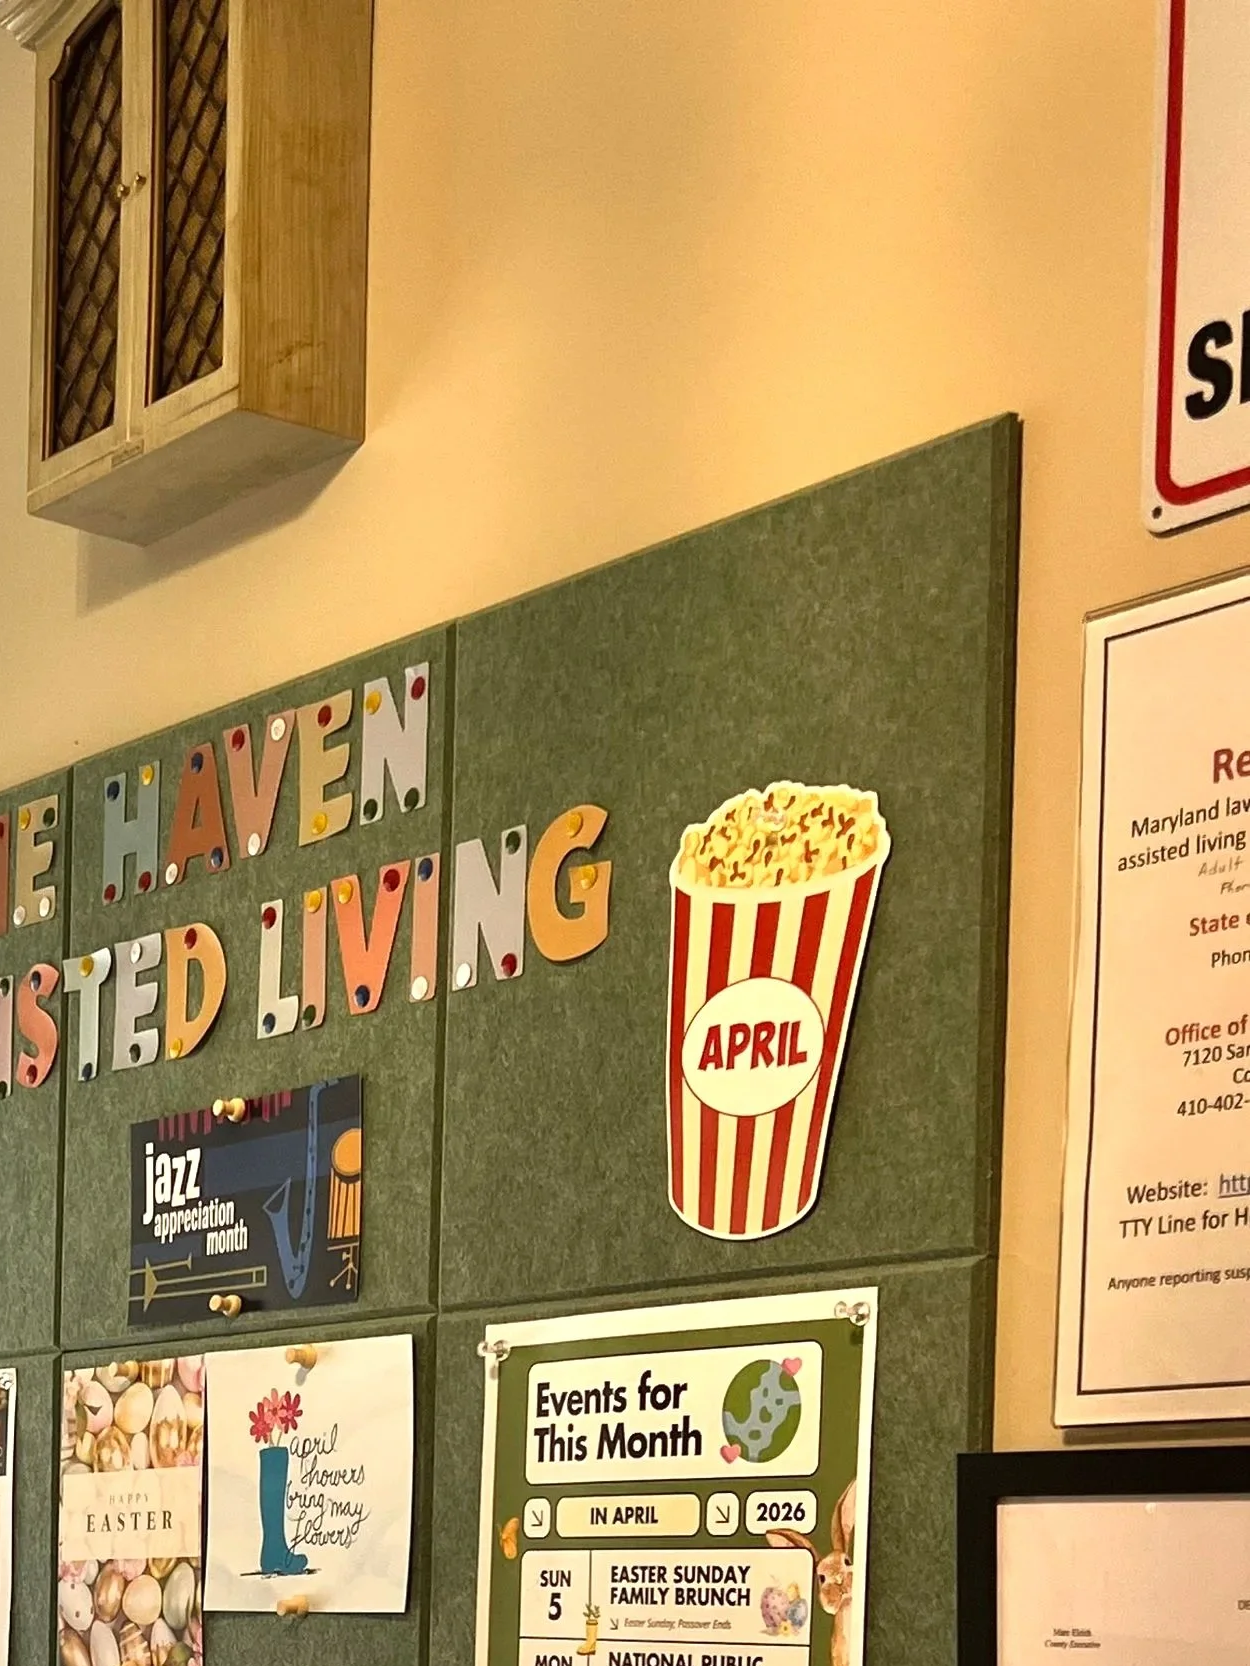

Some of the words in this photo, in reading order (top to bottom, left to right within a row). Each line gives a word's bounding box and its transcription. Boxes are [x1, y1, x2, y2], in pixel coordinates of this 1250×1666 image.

[1185, 309, 1250, 421] S
[102, 661, 430, 905] HAVEN
[1130, 799, 1220, 839] Maryland
[1117, 837, 1190, 872] assisted
[1196, 829, 1247, 855] living
[1198, 856, 1246, 877] Adult
[257, 804, 612, 1040] LIVING
[1189, 911, 1239, 937] State
[697, 1020, 808, 1072] APRIL
[1165, 1021, 1221, 1046] Office
[1227, 1014, 1249, 1036] of
[1182, 1045, 1223, 1067] 7120
[143, 1142, 201, 1225] jazz
[1126, 1179, 1208, 1205] Website:
[153, 1197, 235, 1245] appreciation
[206, 1217, 248, 1256] month
[1119, 1216, 1152, 1239] TTY
[1157, 1213, 1196, 1235] Line
[1202, 1209, 1229, 1231] for
[1107, 1275, 1156, 1292] Anyone
[1159, 1269, 1222, 1288] reporting
[535, 1380, 627, 1419] Events
[637, 1370, 688, 1412] for
[289, 1422, 338, 1473] april
[533, 1423, 588, 1464] This
[596, 1415, 703, 1461] Month
[108, 1492, 150, 1506] HAPPY
[589, 1507, 608, 1526] IN
[613, 1505, 659, 1526] APRIL
[756, 1502, 806, 1524] 2026
[86, 1509, 174, 1534] EASTER
[287, 1510, 358, 1557] flowers
[327, 1498, 371, 1536] may
[539, 1569, 572, 1589] SUN
[610, 1565, 668, 1585] EASTER
[673, 1565, 751, 1585] SUNDAY
[547, 1592, 562, 1621] 5
[610, 1587, 672, 1607] FAMILY
[675, 1586, 751, 1608] BRUNCH
